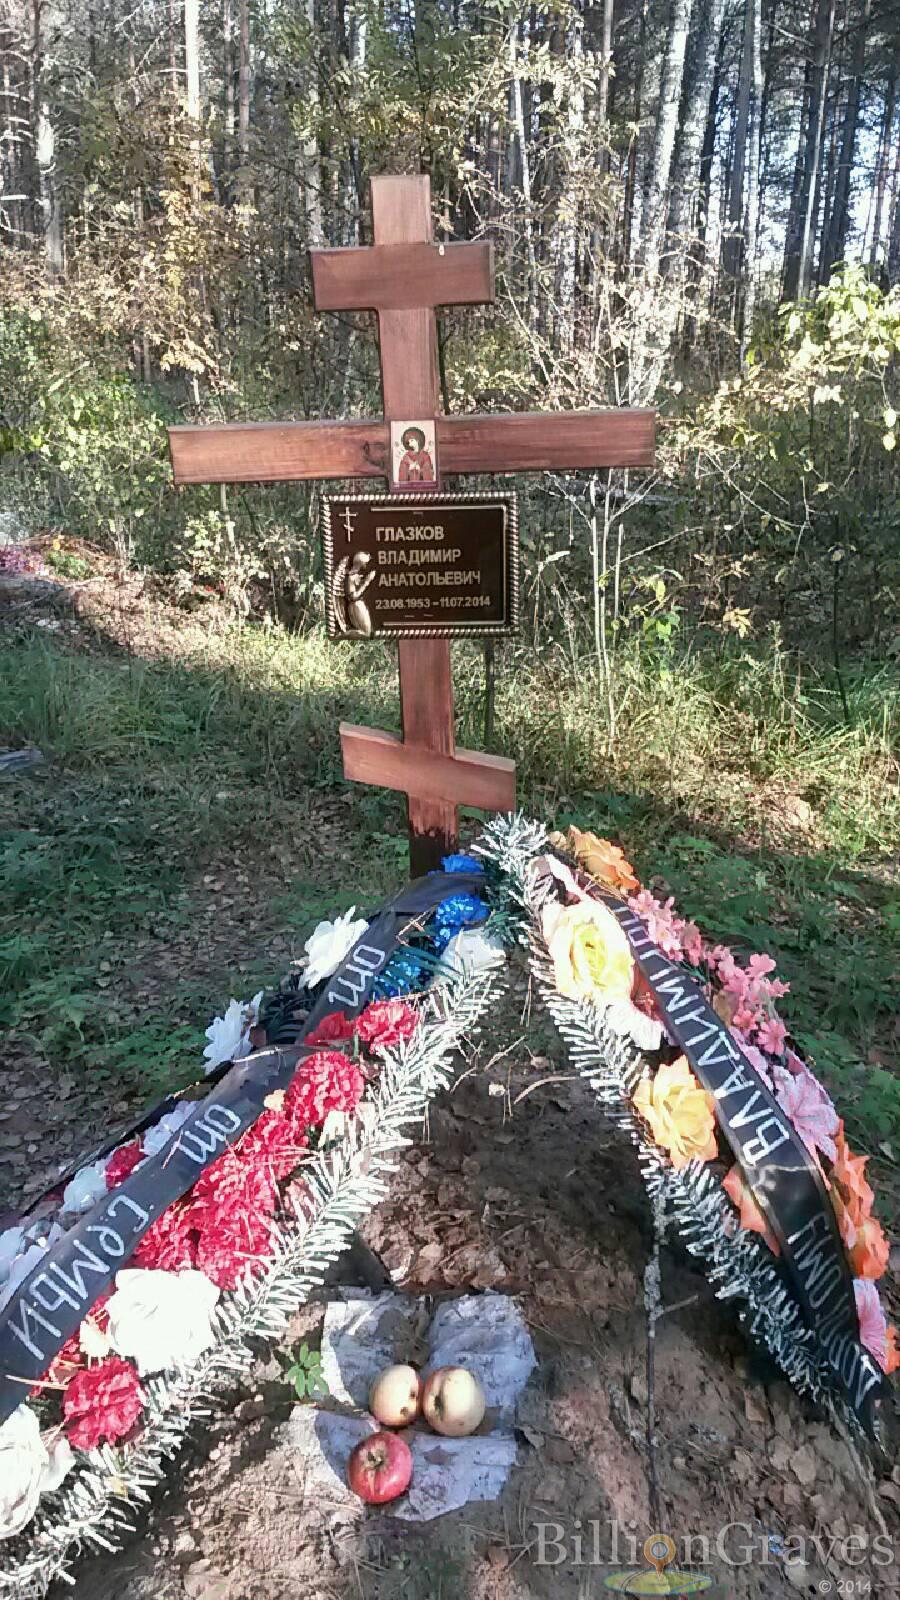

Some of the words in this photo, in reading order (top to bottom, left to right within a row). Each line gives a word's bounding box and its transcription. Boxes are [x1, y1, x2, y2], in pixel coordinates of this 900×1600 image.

[375, 526, 445, 542] ГЛАЗКОВ
[378, 548, 462, 566] ВЛАДИМИР
[378, 570, 481, 587] АНАТОЛЬЕВИЧ
